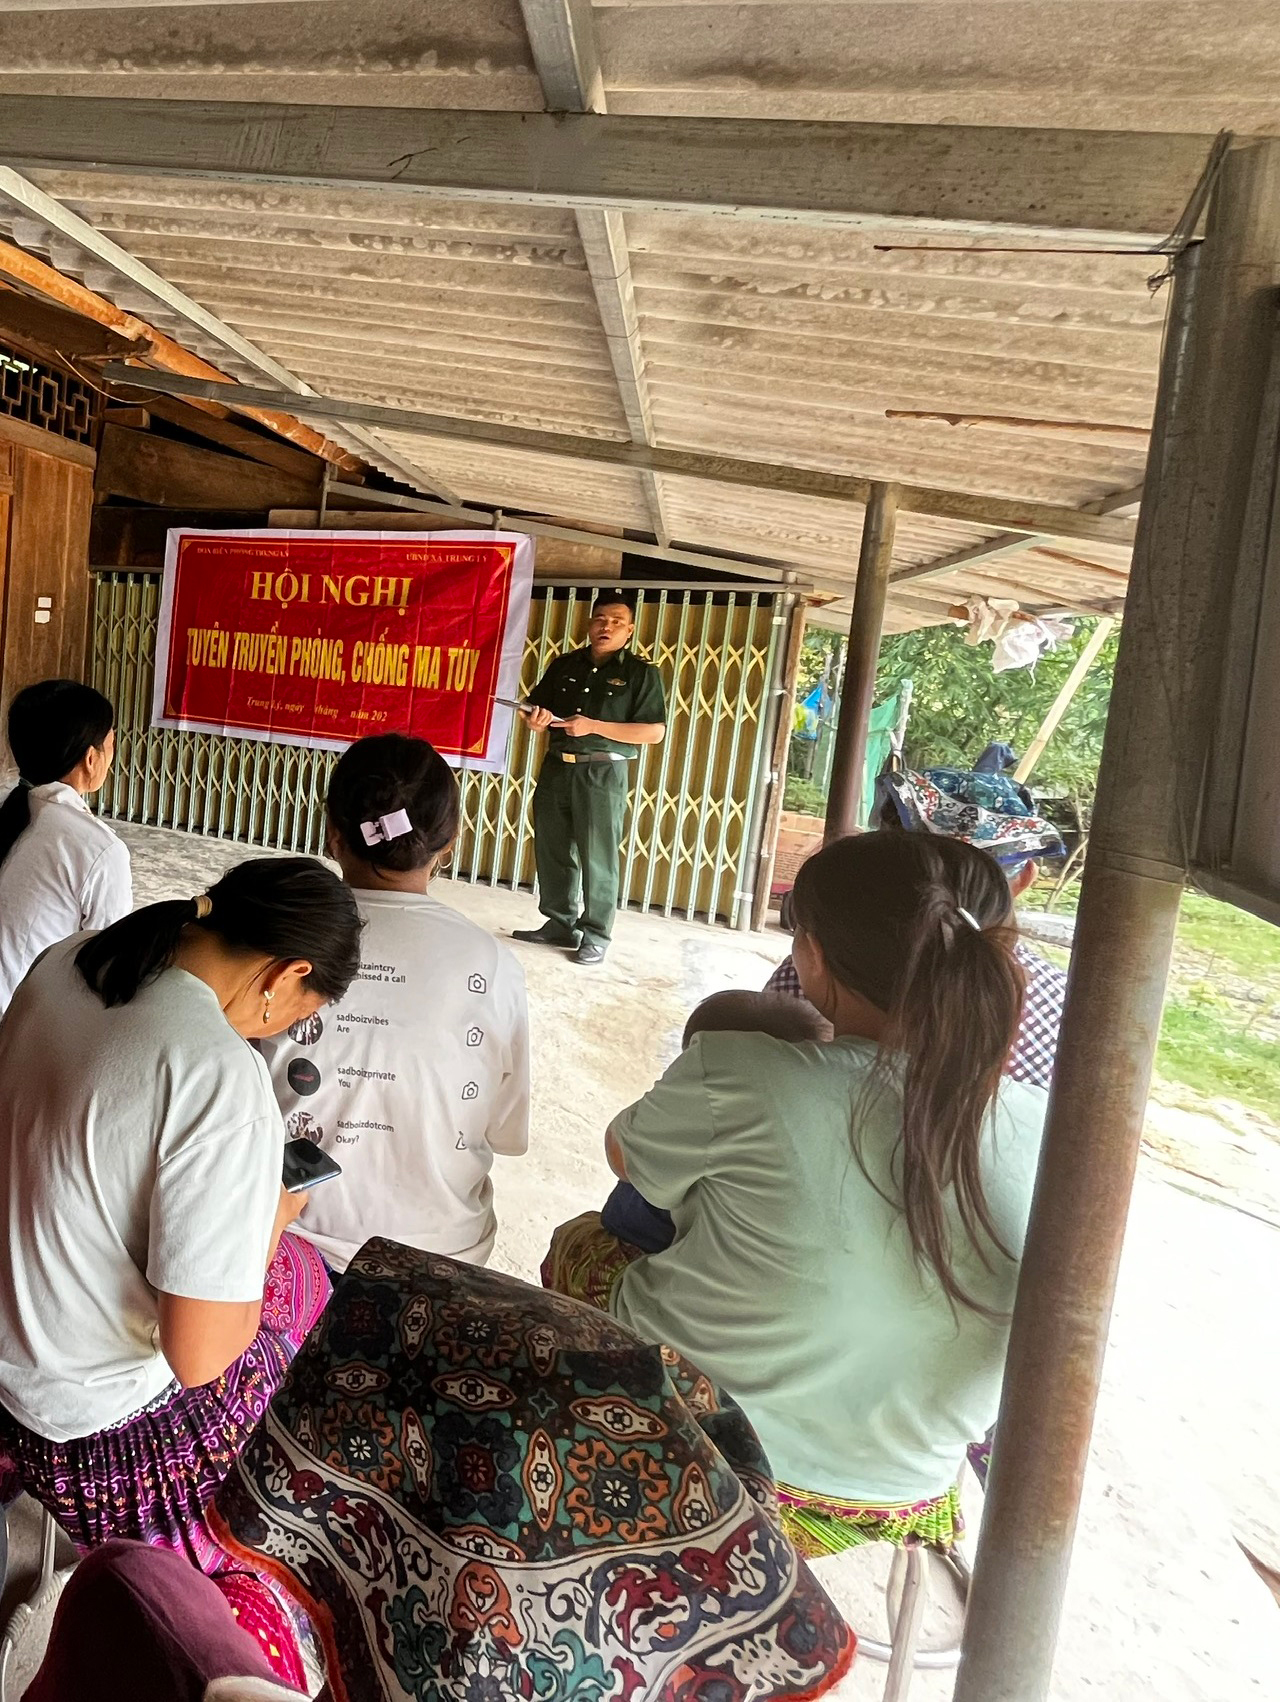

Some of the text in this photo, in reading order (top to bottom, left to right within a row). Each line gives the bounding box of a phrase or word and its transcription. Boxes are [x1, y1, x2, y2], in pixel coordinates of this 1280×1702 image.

[249, 567, 414, 616] HỘI NGHỊ
[186, 621, 480, 693] TUYÊN TRUYỀN PHÒNG, CHỐNG MA TÚY
[247, 696, 269, 709] Trung
[315, 704, 339, 719] tháng
[358, 961, 396, 974] izaintcry
[391, 975, 406, 983] call
[336, 1013, 389, 1026] sadboizvibes
[336, 1025, 350, 1034] Are
[337, 1067, 397, 1082] sadboizprivate
[338, 1079, 351, 1088] You
[337, 1119, 395, 1133] sadboizdotcom
[335, 1134, 360, 1145] Okay?
